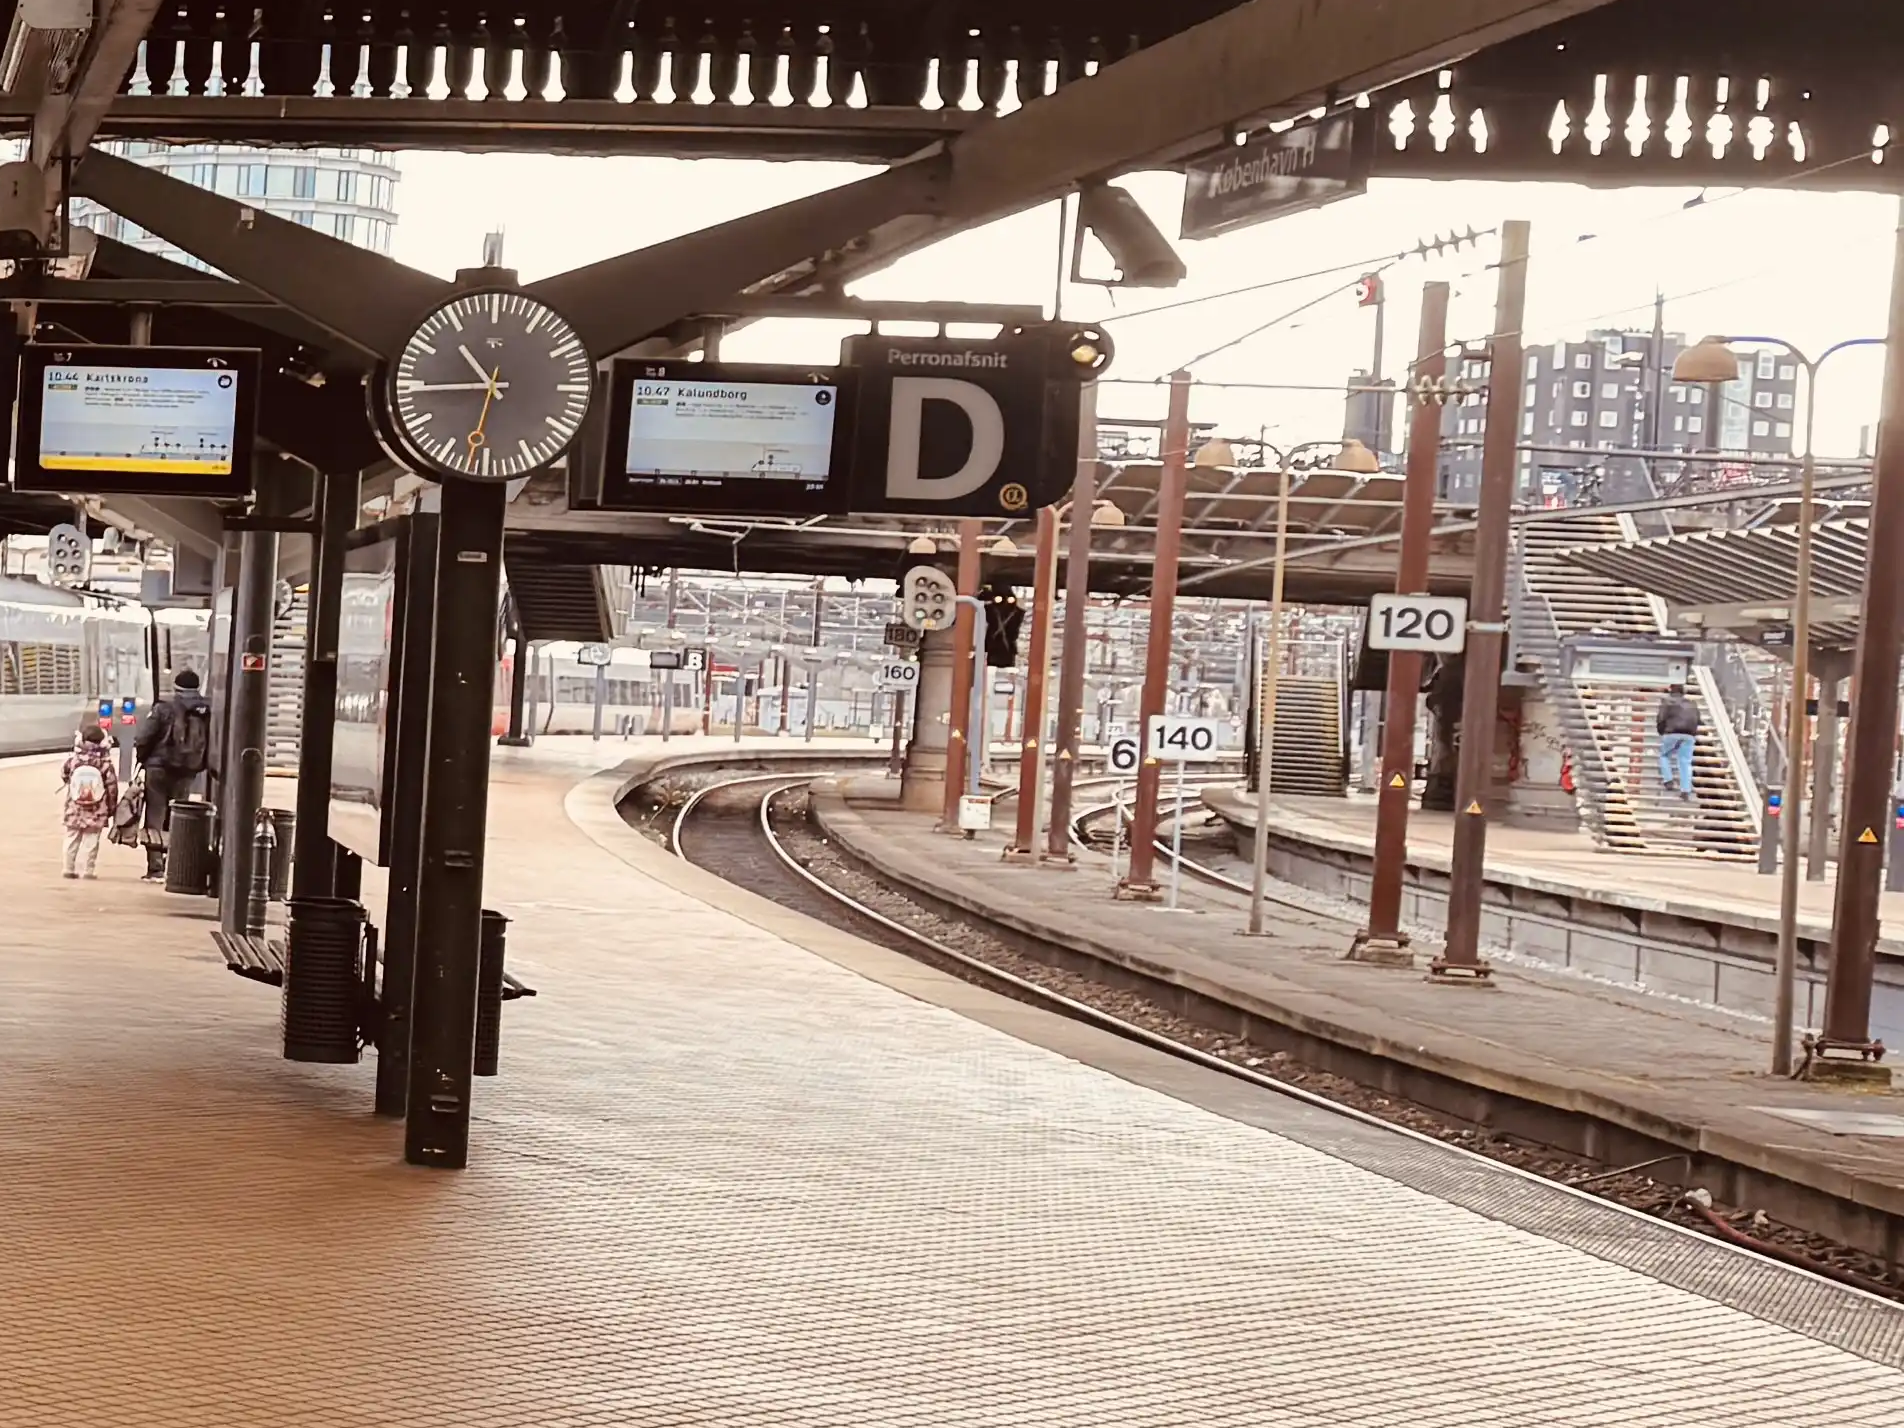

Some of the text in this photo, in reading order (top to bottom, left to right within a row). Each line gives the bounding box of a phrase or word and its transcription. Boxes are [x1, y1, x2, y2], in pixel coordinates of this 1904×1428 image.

[1207, 130, 1318, 199] København H
[888, 349, 1009, 368] Perronafsnit
[677, 387, 747, 401] Kalundborg
[885, 376, 1005, 500] D
[1378, 606, 1455, 641] 120
[884, 664, 916, 681] 160
[1155, 725, 1213, 751] 140
[1112, 739, 1137, 769] 6
